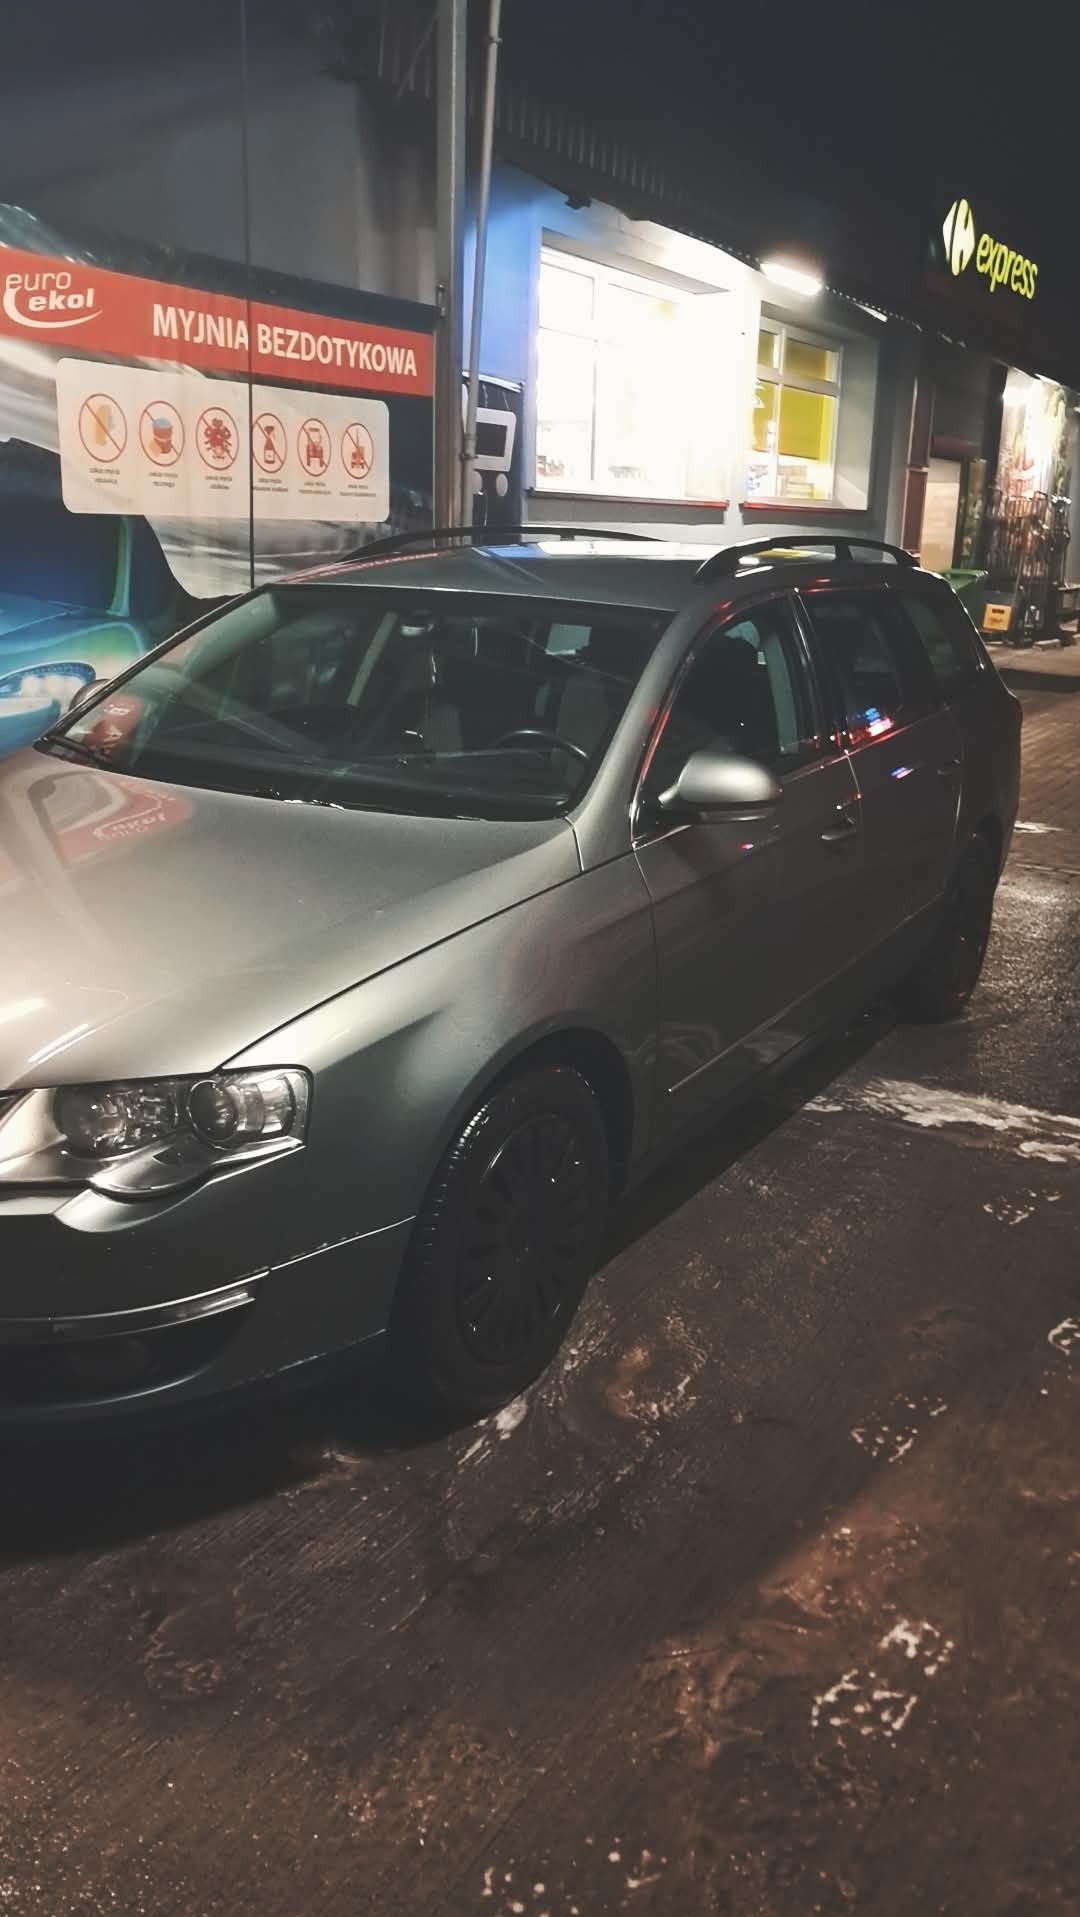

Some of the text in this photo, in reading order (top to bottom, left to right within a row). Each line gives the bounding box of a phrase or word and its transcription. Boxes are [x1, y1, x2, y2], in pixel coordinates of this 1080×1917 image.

[5, 272, 72, 292] euro
[976, 233, 1039, 300] express
[28, 287, 95, 312] ekol
[152, 303, 418, 377] MYJNIA BEZDOTYKOWA
